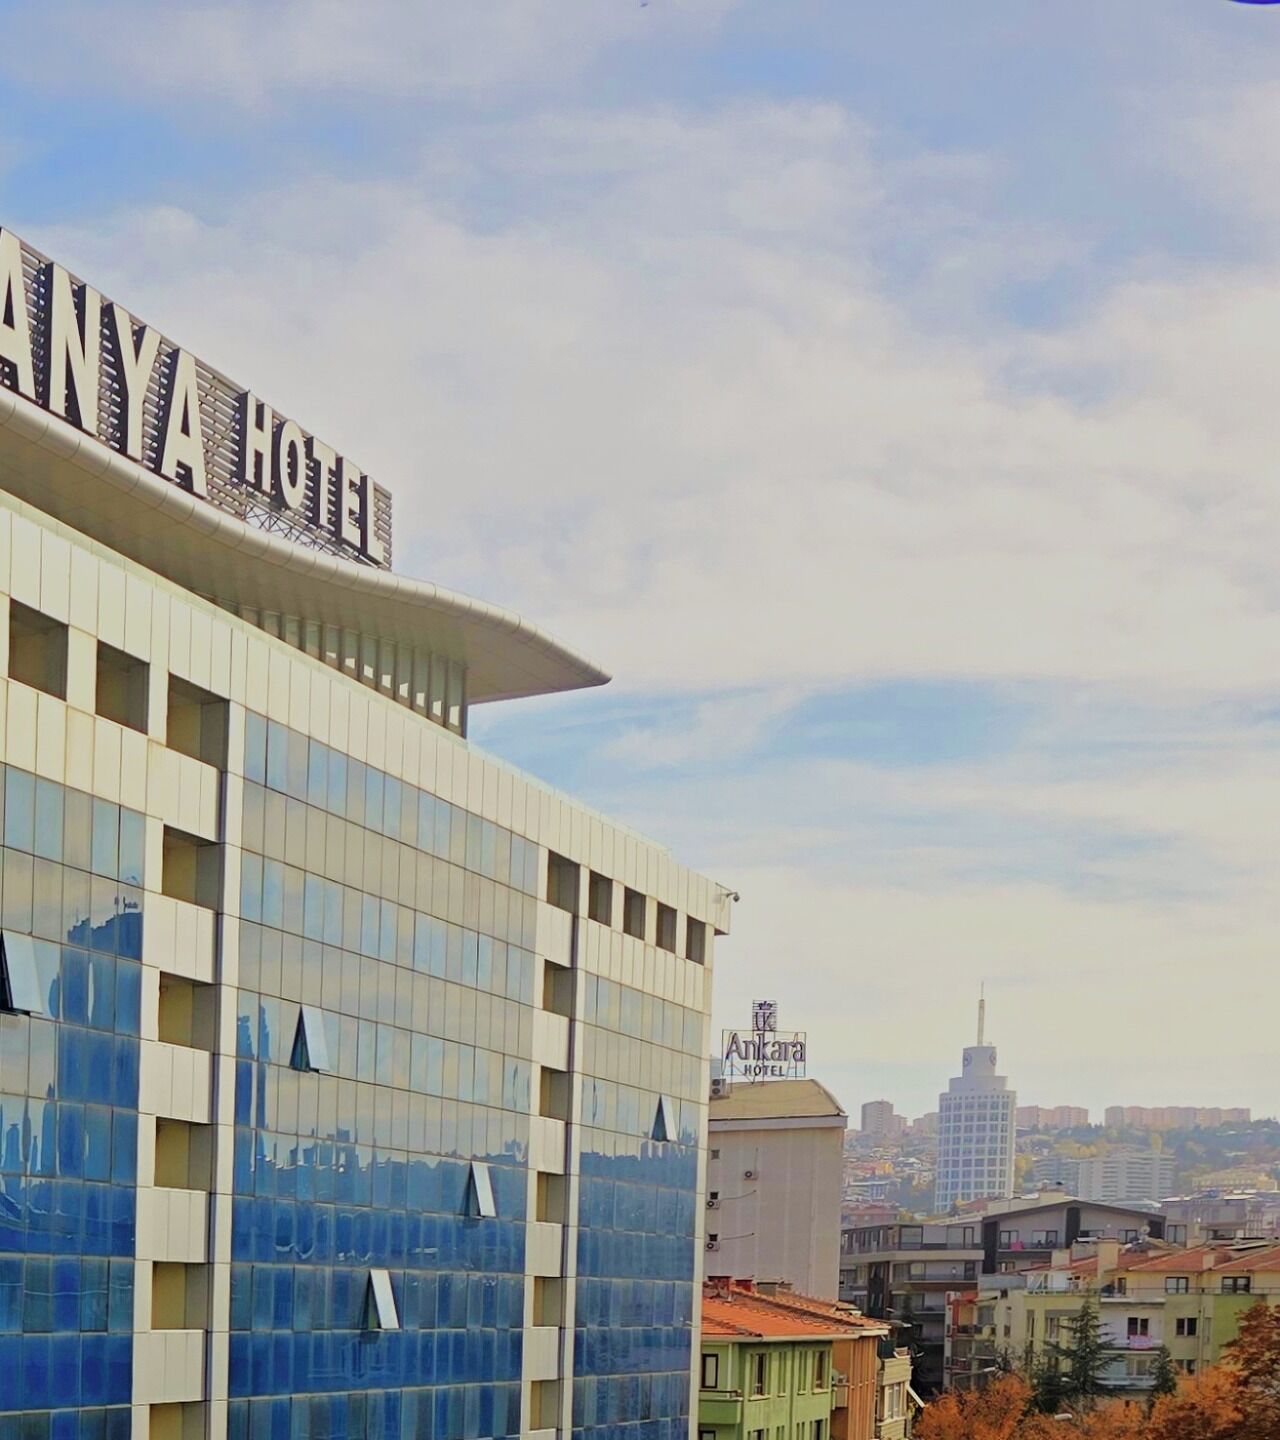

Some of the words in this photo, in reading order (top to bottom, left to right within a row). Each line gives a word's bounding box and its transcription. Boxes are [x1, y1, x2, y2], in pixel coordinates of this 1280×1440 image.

[243, 392, 386, 565] HOTEL
[725, 1032, 806, 1062] Ankara
[744, 1064, 785, 1077] HOTEL
